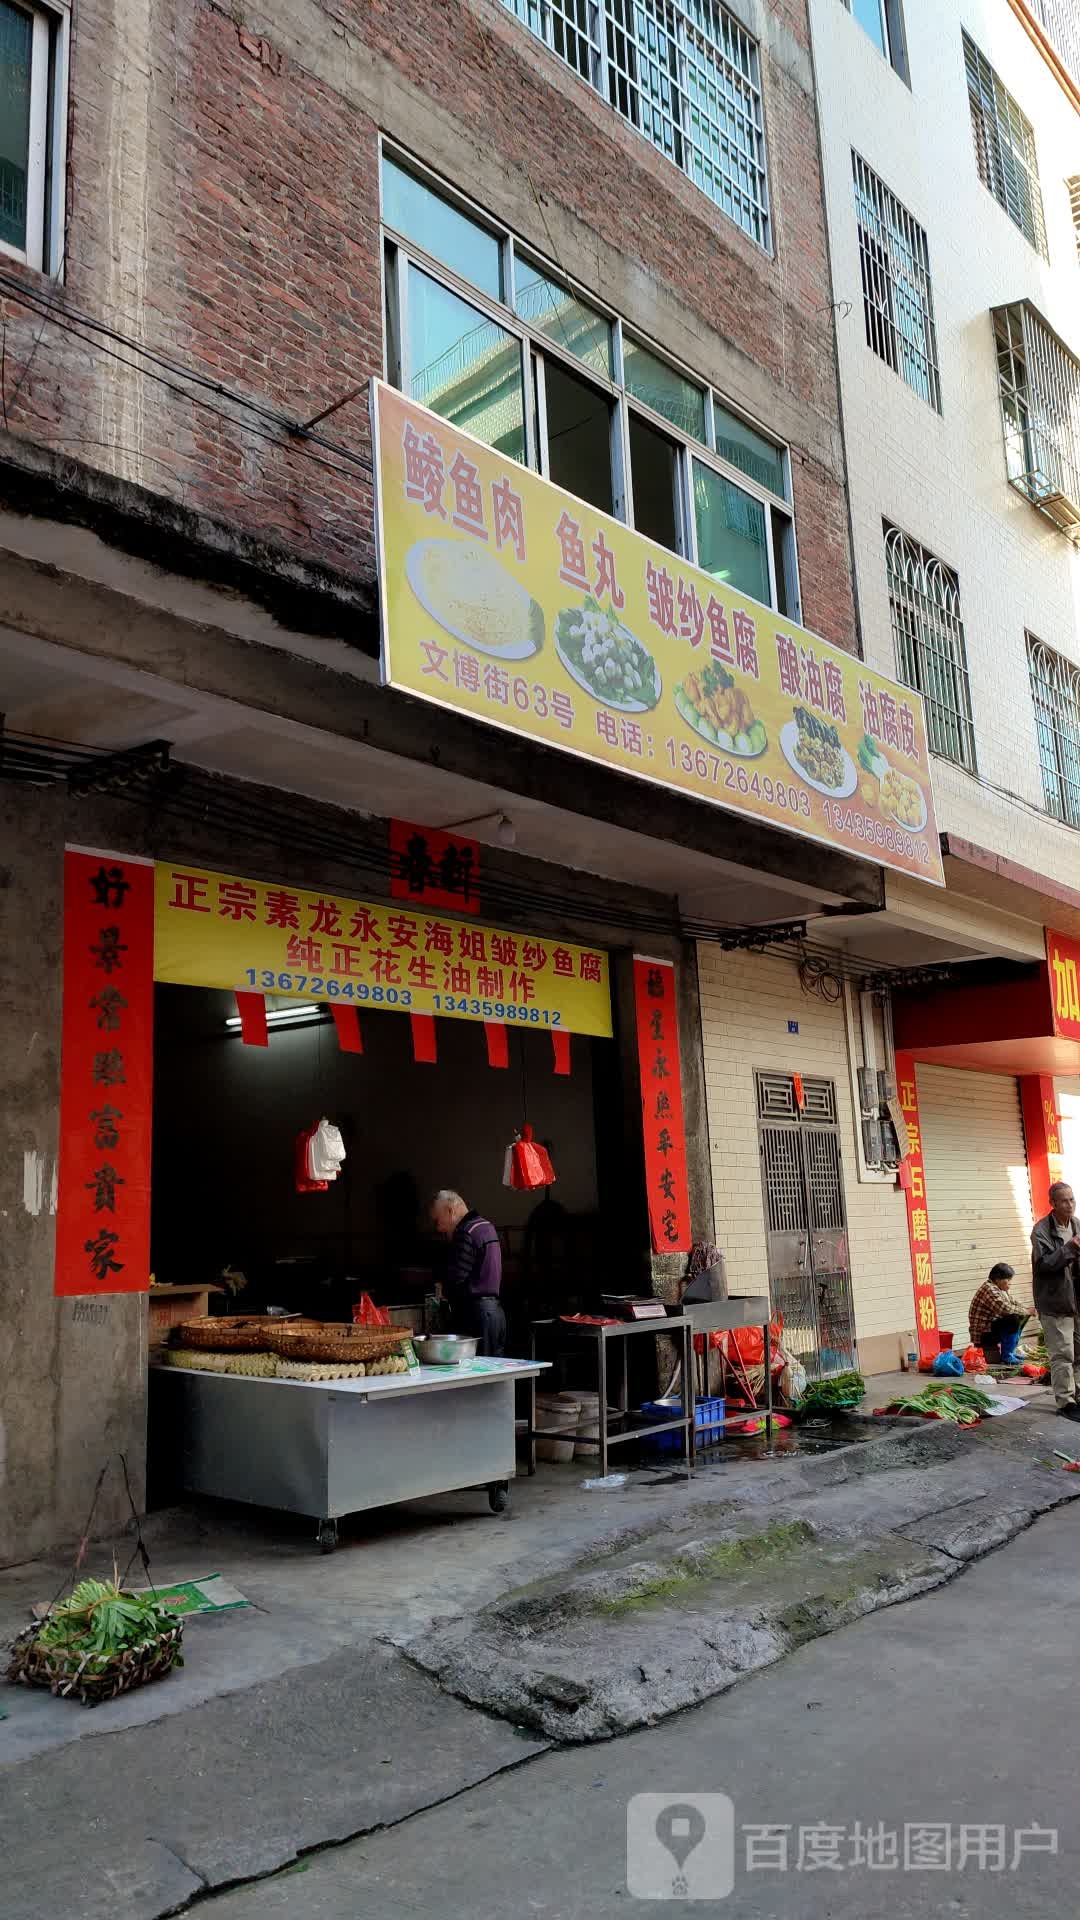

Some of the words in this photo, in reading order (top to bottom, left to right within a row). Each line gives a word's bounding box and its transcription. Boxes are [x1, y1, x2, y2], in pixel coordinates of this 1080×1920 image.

[403, 423, 525, 561] 鲮鱼肉
[555, 511, 625, 609] 鱼丸
[646, 560, 760, 680] 皱纱鱼腐
[775, 633, 847, 724] 酿油腐
[858, 680, 920, 761] 油腐皮
[419, 640, 575, 729] 文博街63号
[823, 800, 930, 864] 13435989812
[168, 872, 602, 983] 正宗素龙永安海姐皱纱鱼腐
[245, 968, 412, 1006] 13672649803
[433, 994, 561, 1026] 13435989812
[286, 934, 536, 1004] 纯正花生油制作
[900, 1081, 935, 1331] 正宗石磨肠粉
